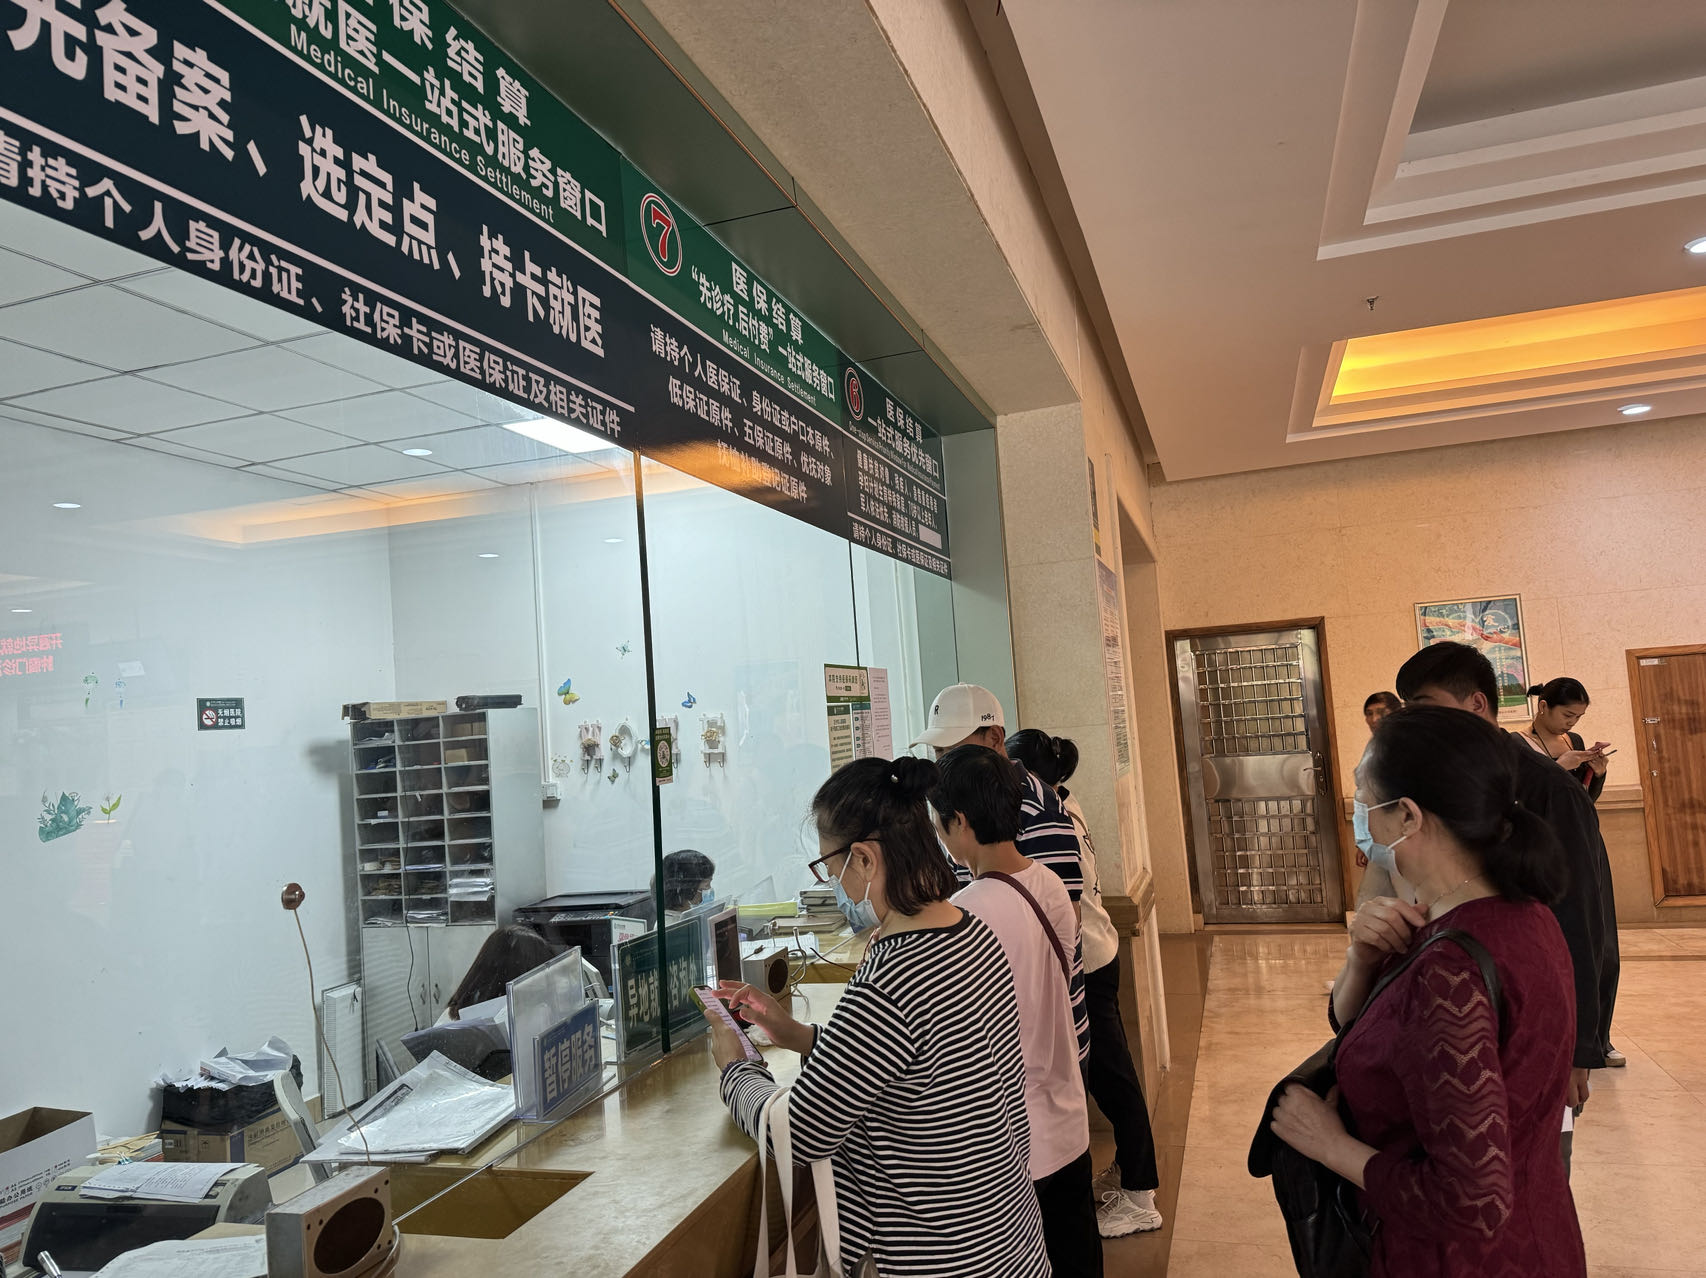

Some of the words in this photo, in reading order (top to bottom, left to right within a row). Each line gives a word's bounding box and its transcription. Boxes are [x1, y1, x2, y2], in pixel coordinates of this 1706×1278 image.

[365, 0, 531, 127] 保结算
[290, 23, 374, 100] Medical
[382, 88, 470, 165] Insurance
[477, 155, 554, 223] Settlement
[651, 203, 674, 262] 7
[731, 260, 804, 345] 医保结算
[722, 328, 750, 359] Medical
[754, 353, 785, 384] Insurance
[787, 376, 817, 407] Settlement
[850, 377, 861, 412] 6
[886, 396, 923, 444] 医保结算
[543, 1023, 596, 1103] 暂停服务
